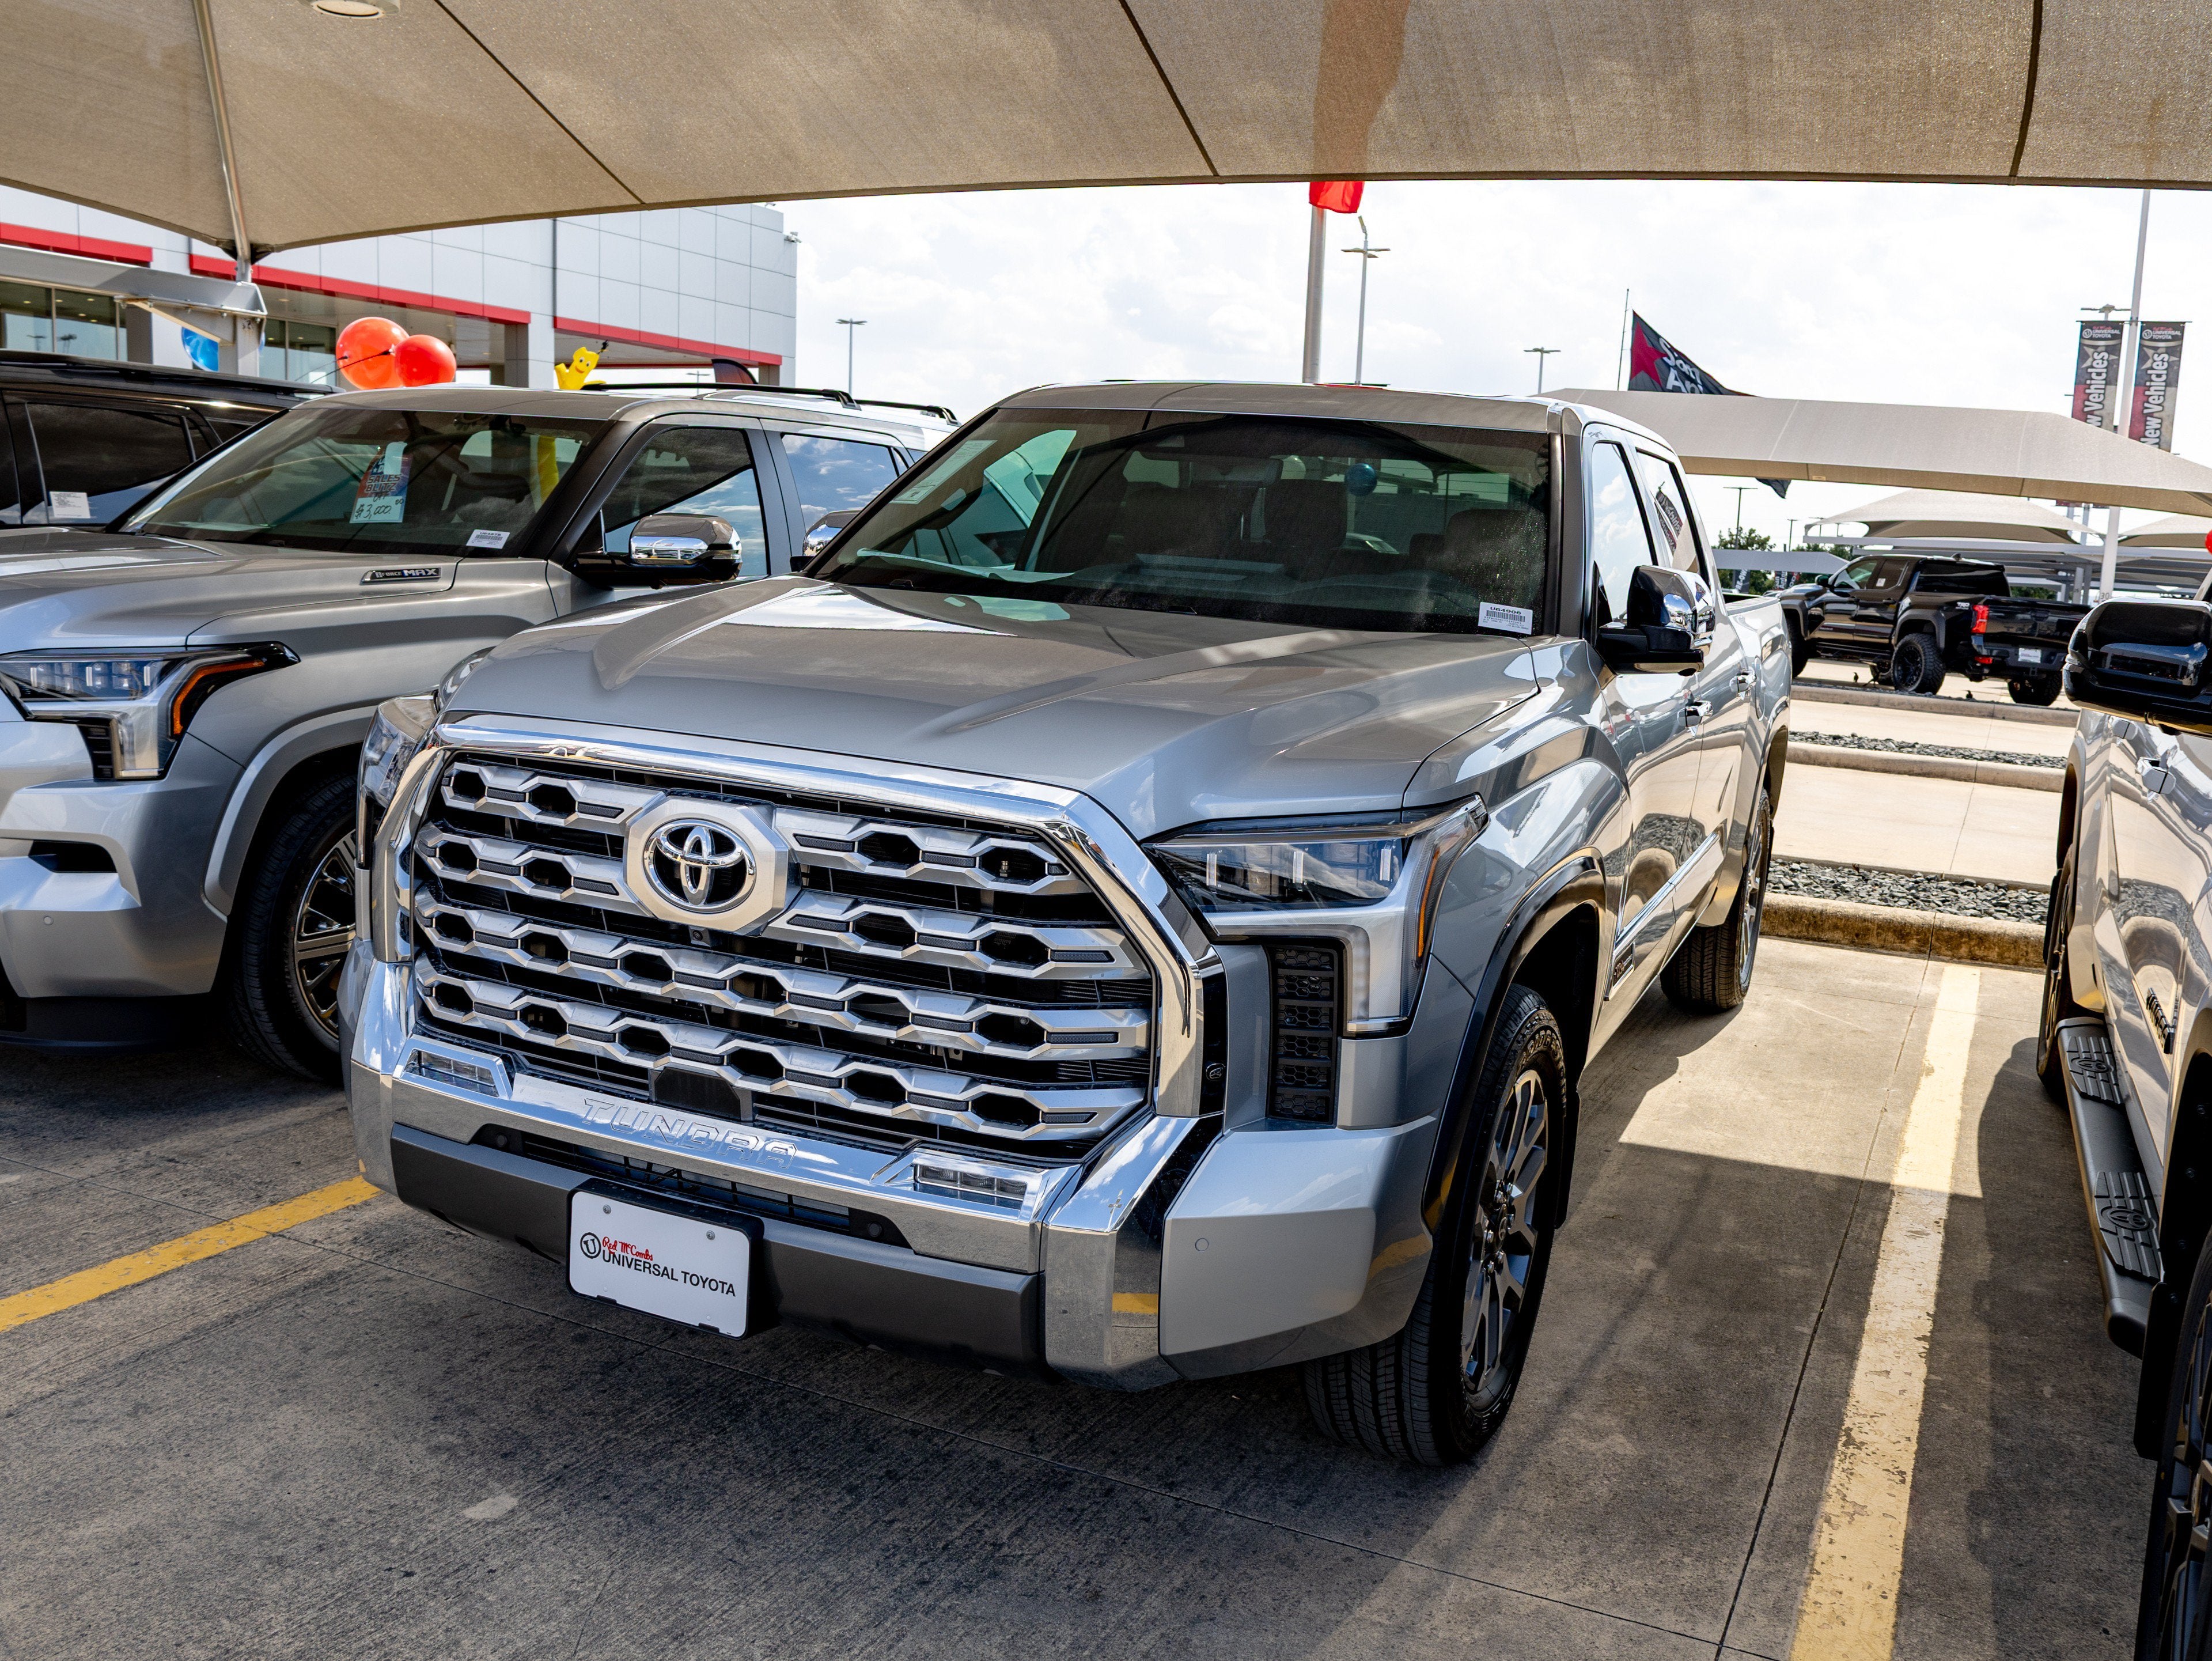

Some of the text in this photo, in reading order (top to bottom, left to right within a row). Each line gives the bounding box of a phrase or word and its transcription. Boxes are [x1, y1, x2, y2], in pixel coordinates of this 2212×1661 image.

[1659, 337, 1703, 385] San
[2084, 351, 2108, 412] Vehicles
[2143, 353, 2169, 414] Vehicles
[2140, 417, 2162, 448] New
[365, 483, 397, 493] BLITZ
[368, 474, 402, 483] SALES
[404, 569, 438, 577] MAX
[1490, 606, 1521, 615] U64906
[582, 1097, 798, 1169] TUNDRA
[602, 1236, 618, 1255] Red
[619, 1240, 653, 1261] McCombs
[602, 1249, 736, 1297] UNIVERSAL TOYOTA
